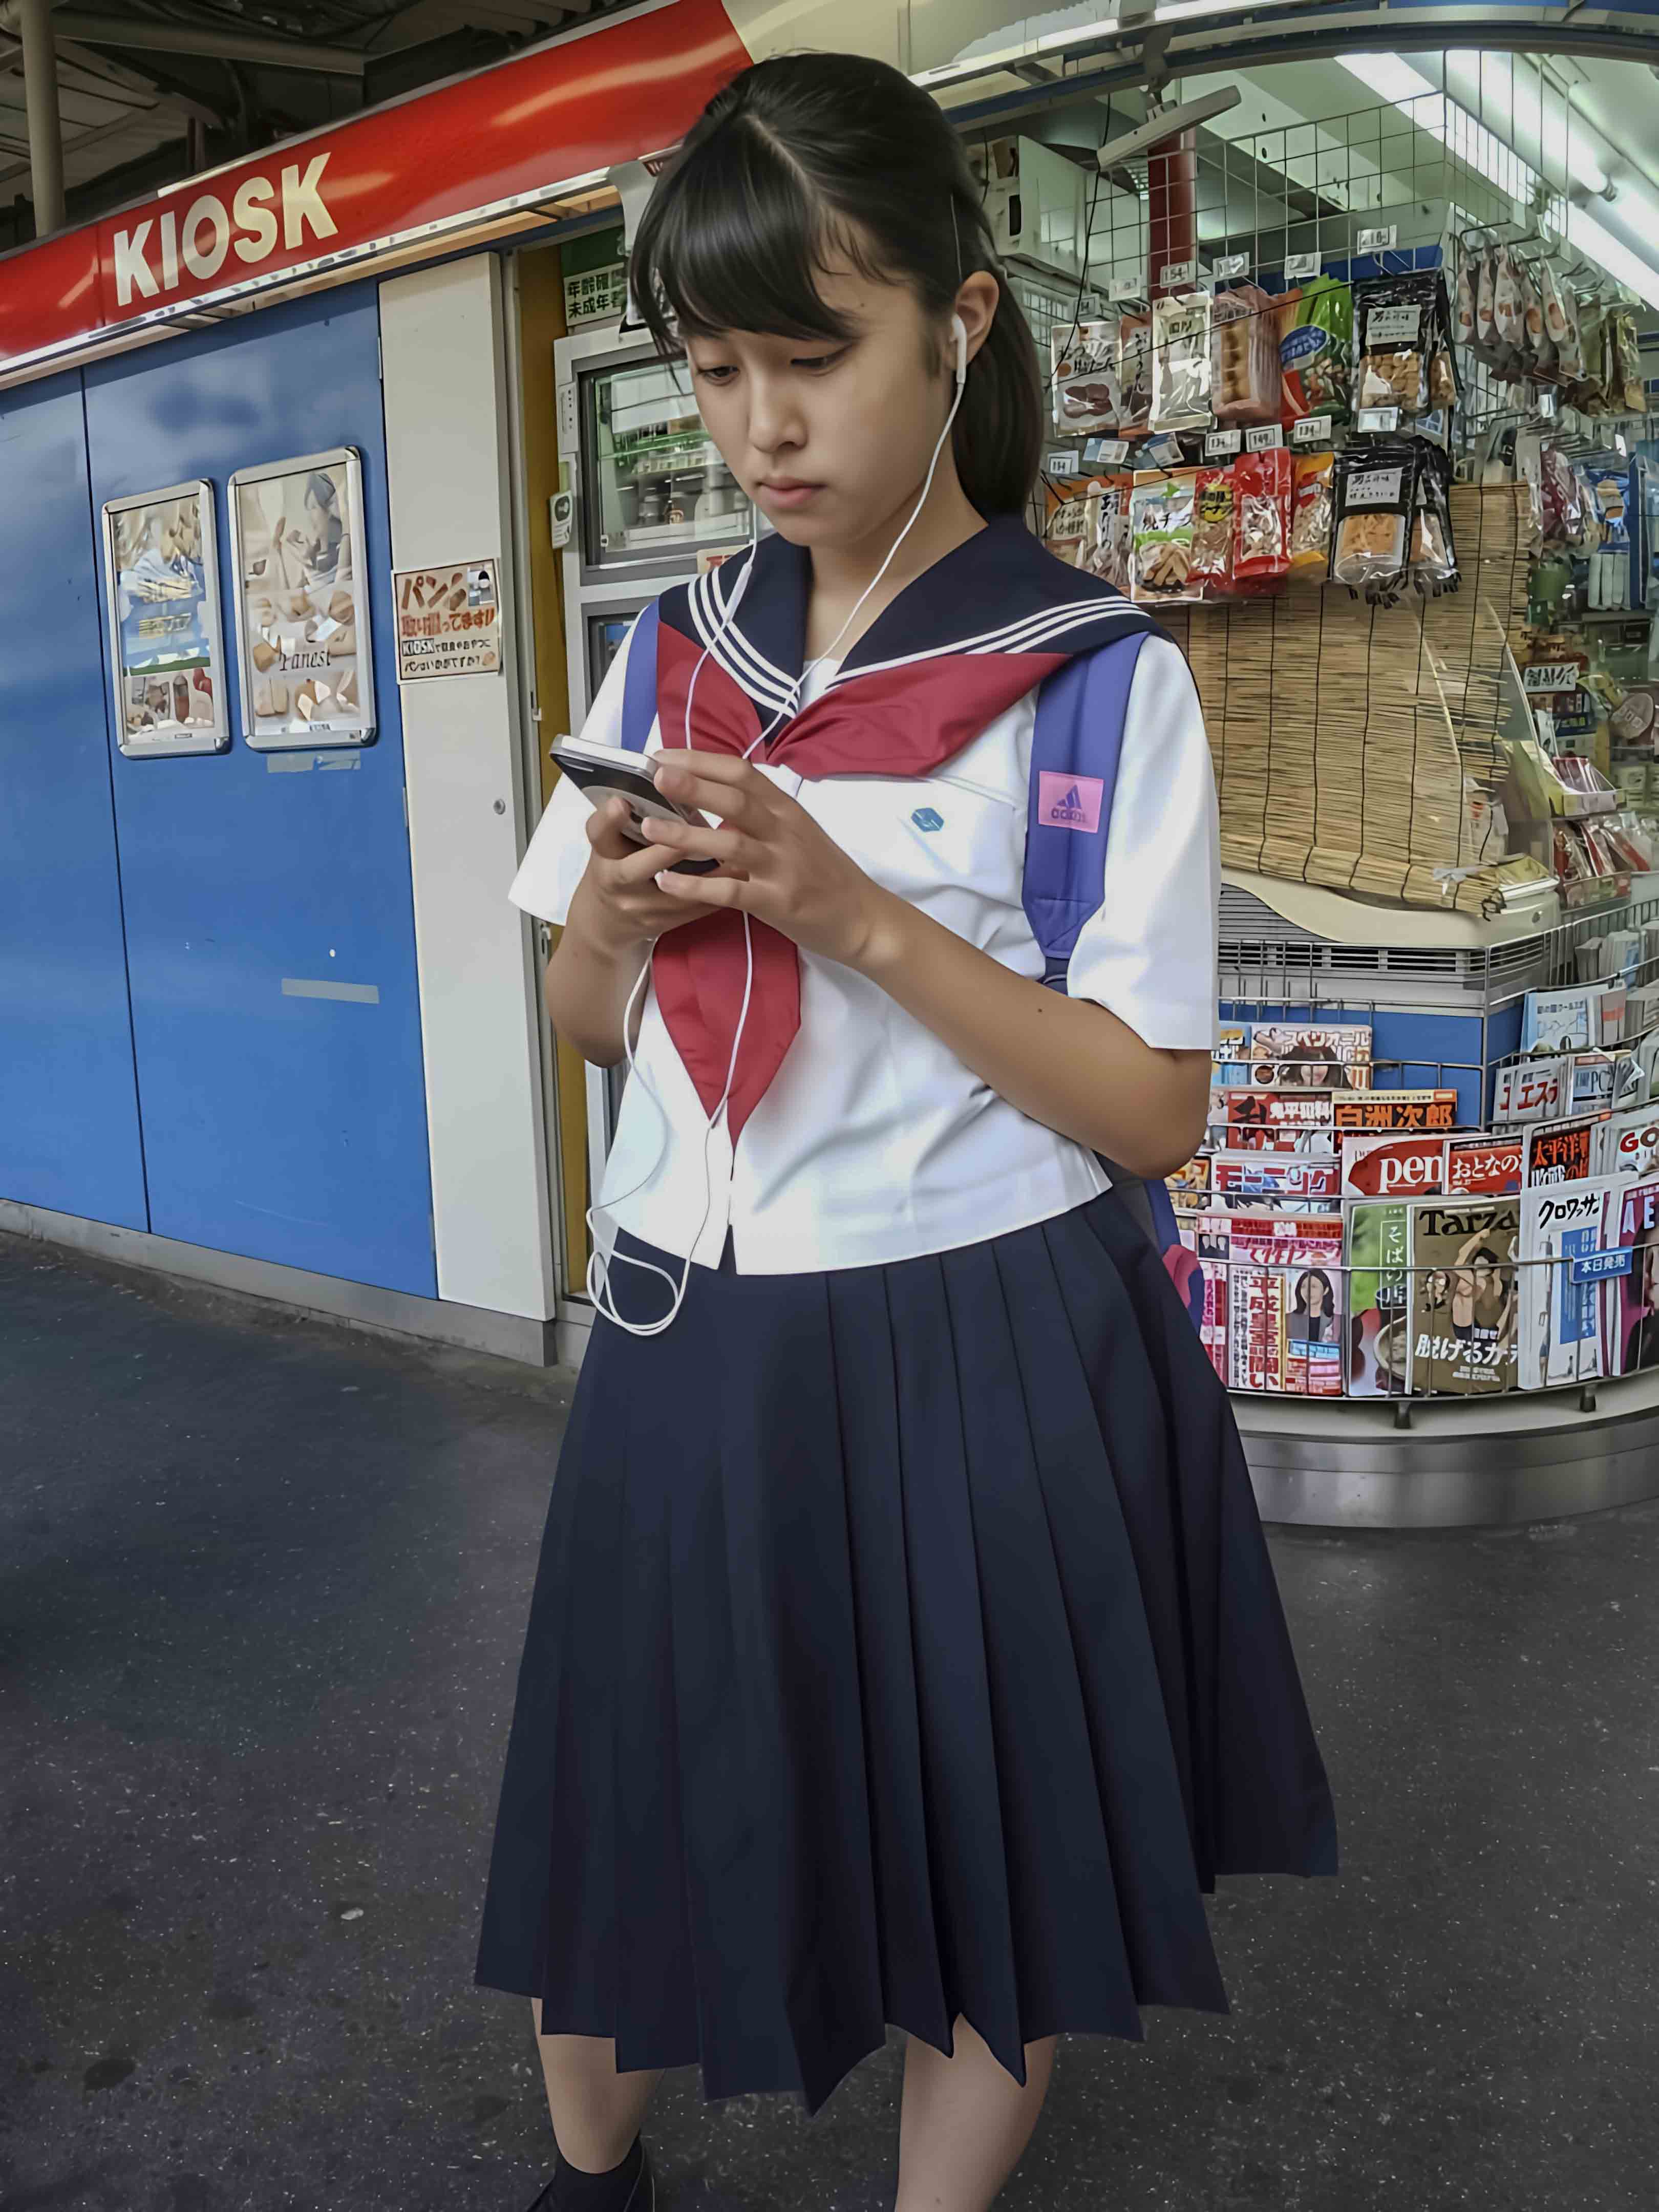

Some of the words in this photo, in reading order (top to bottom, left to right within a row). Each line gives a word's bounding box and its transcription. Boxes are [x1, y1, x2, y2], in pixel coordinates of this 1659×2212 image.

[114, 152, 338, 307] KIOSK
[401, 575, 449, 610] パン
[1377, 1155, 1442, 1194] pen
[1452, 1153, 1523, 1179] おとなの
[1581, 1254, 1626, 1273] 本日発売
